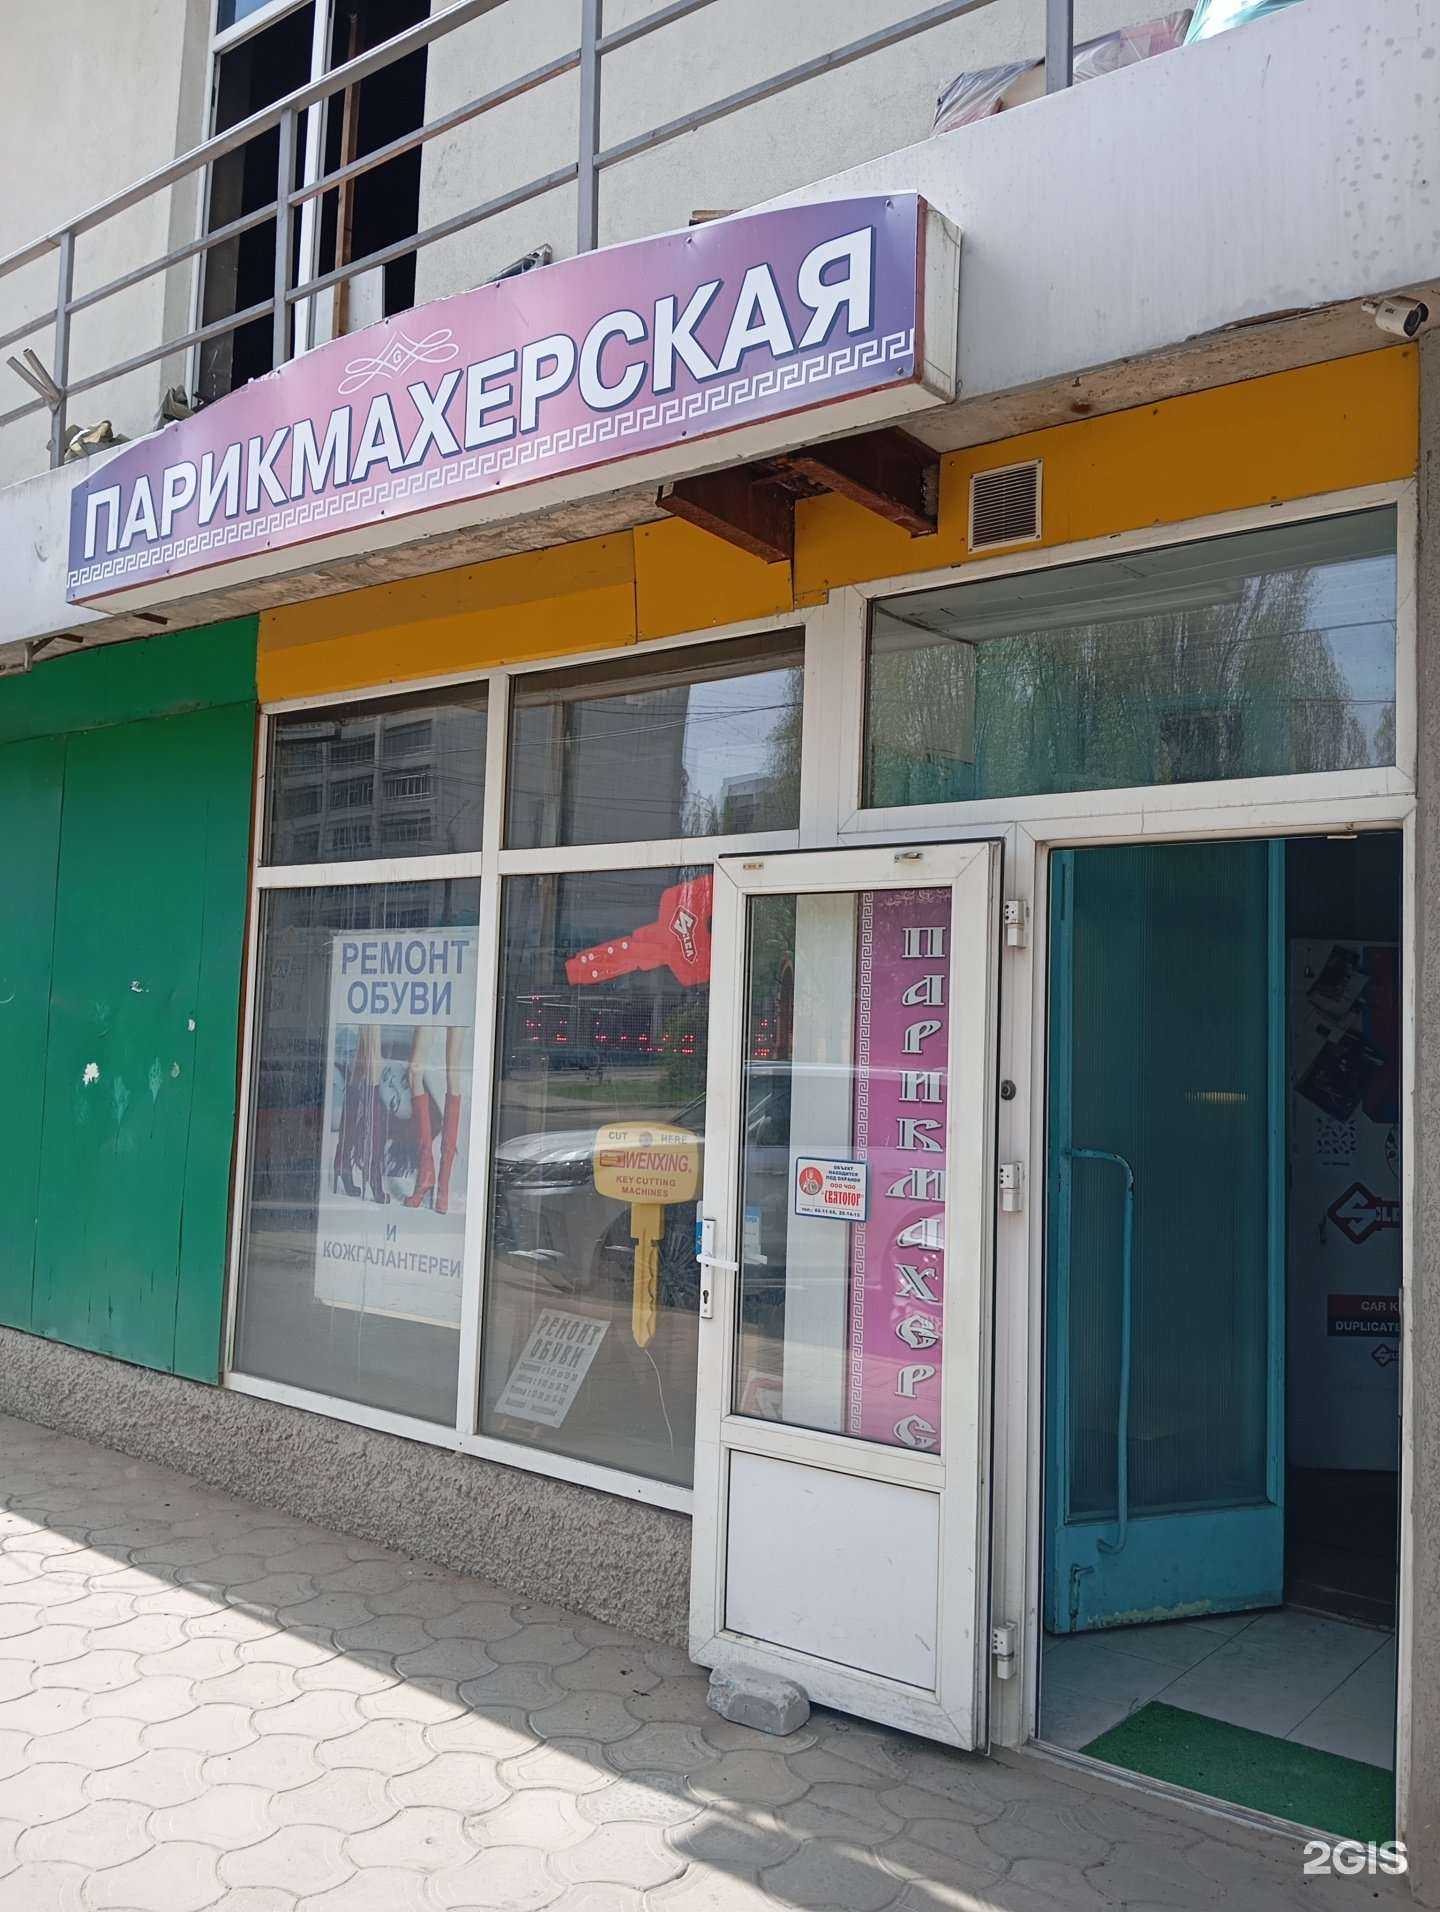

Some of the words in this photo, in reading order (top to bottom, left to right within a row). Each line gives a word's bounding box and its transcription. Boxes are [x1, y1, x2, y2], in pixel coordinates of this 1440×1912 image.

[83, 225, 876, 560] ПАРИКМАХЕРСКАЯ
[341, 940, 470, 975] РЕМОНТ
[347, 980, 452, 1015] ОБУВИ
[608, 1131, 628, 1141] CUT
[660, 1133, 688, 1145] HERE
[625, 1151, 690, 1173] WENXING
[616, 1175, 634, 1184] KEY
[636, 1177, 676, 1187] CUTTING
[621, 1186, 669, 1198] MACHINES
[386, 1223, 398, 1243] И
[1361, 1301, 1386, 1312] CAR
